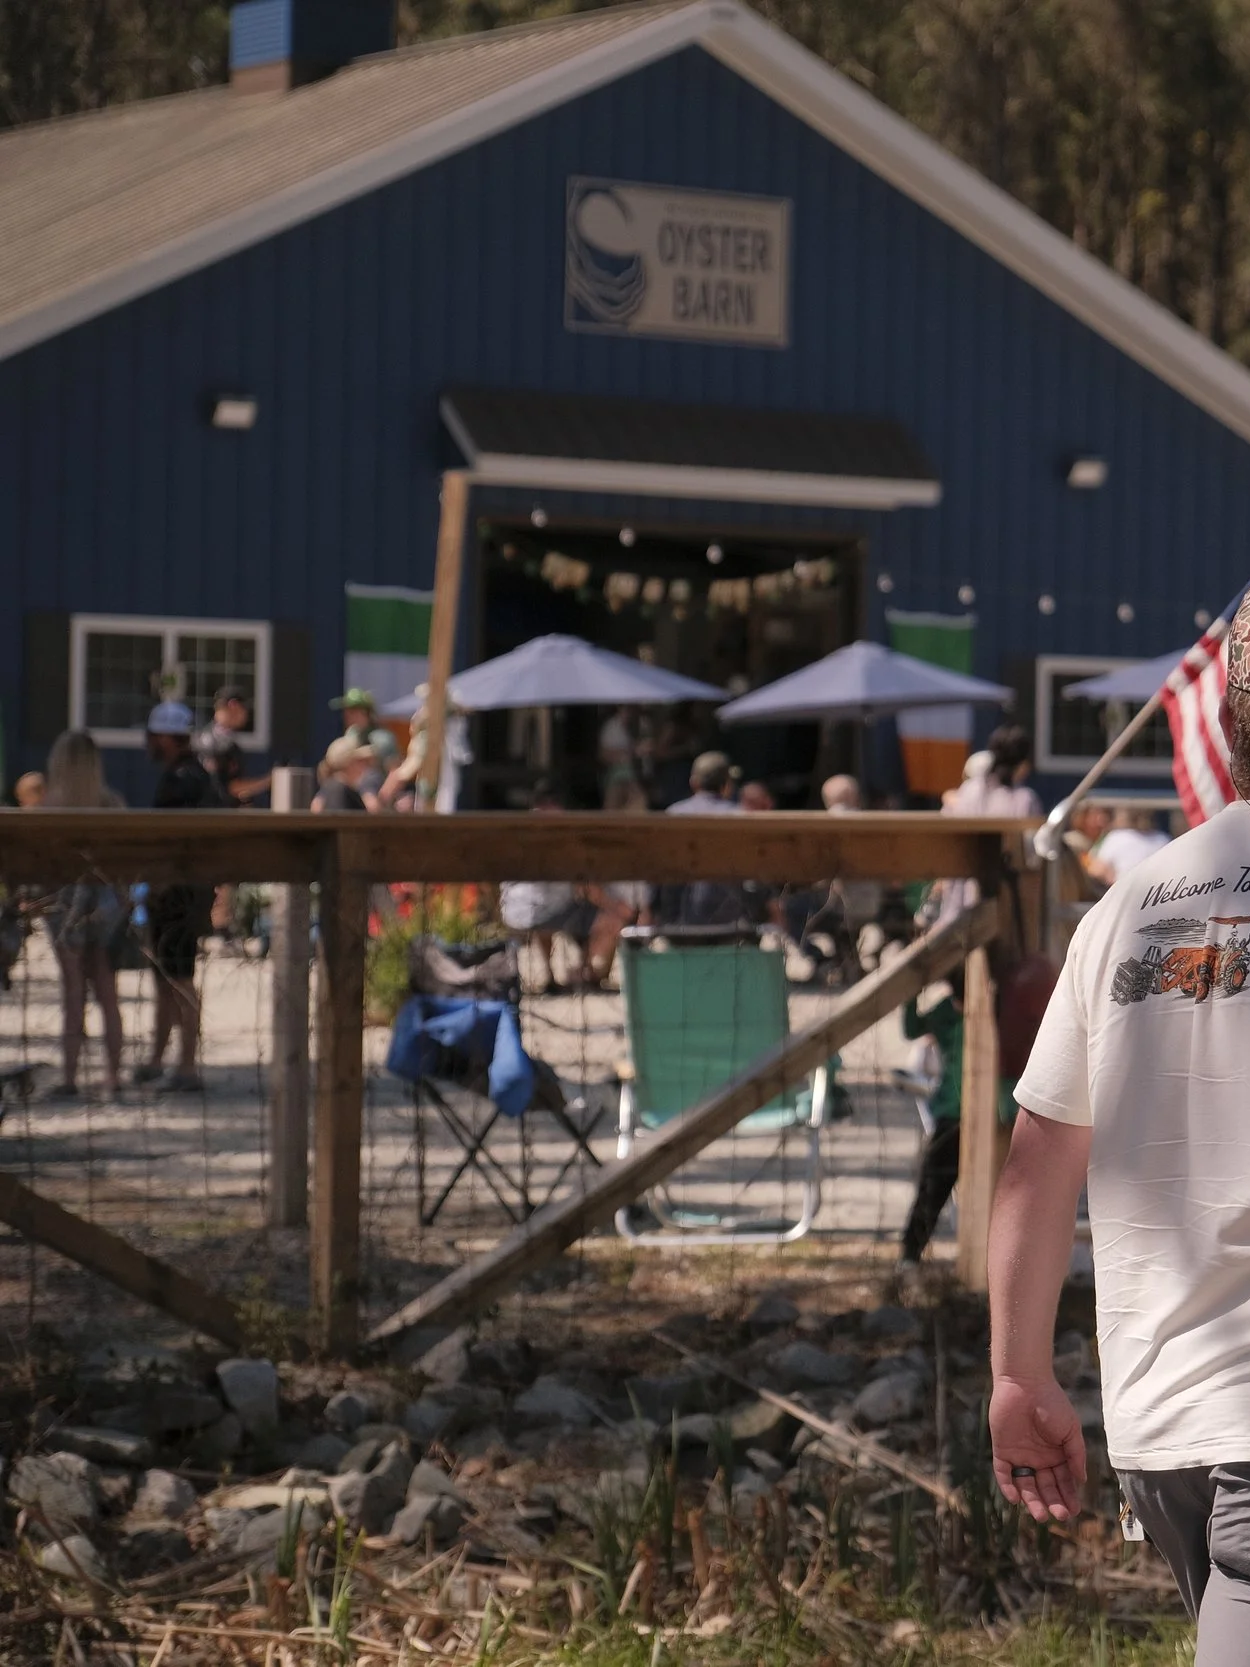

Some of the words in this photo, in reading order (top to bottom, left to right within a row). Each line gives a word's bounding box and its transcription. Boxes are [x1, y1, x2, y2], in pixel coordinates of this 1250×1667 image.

[657, 220, 773, 274] OYSTER
[672, 275, 756, 326] BARN
[1140, 875, 1226, 910] Welcome
